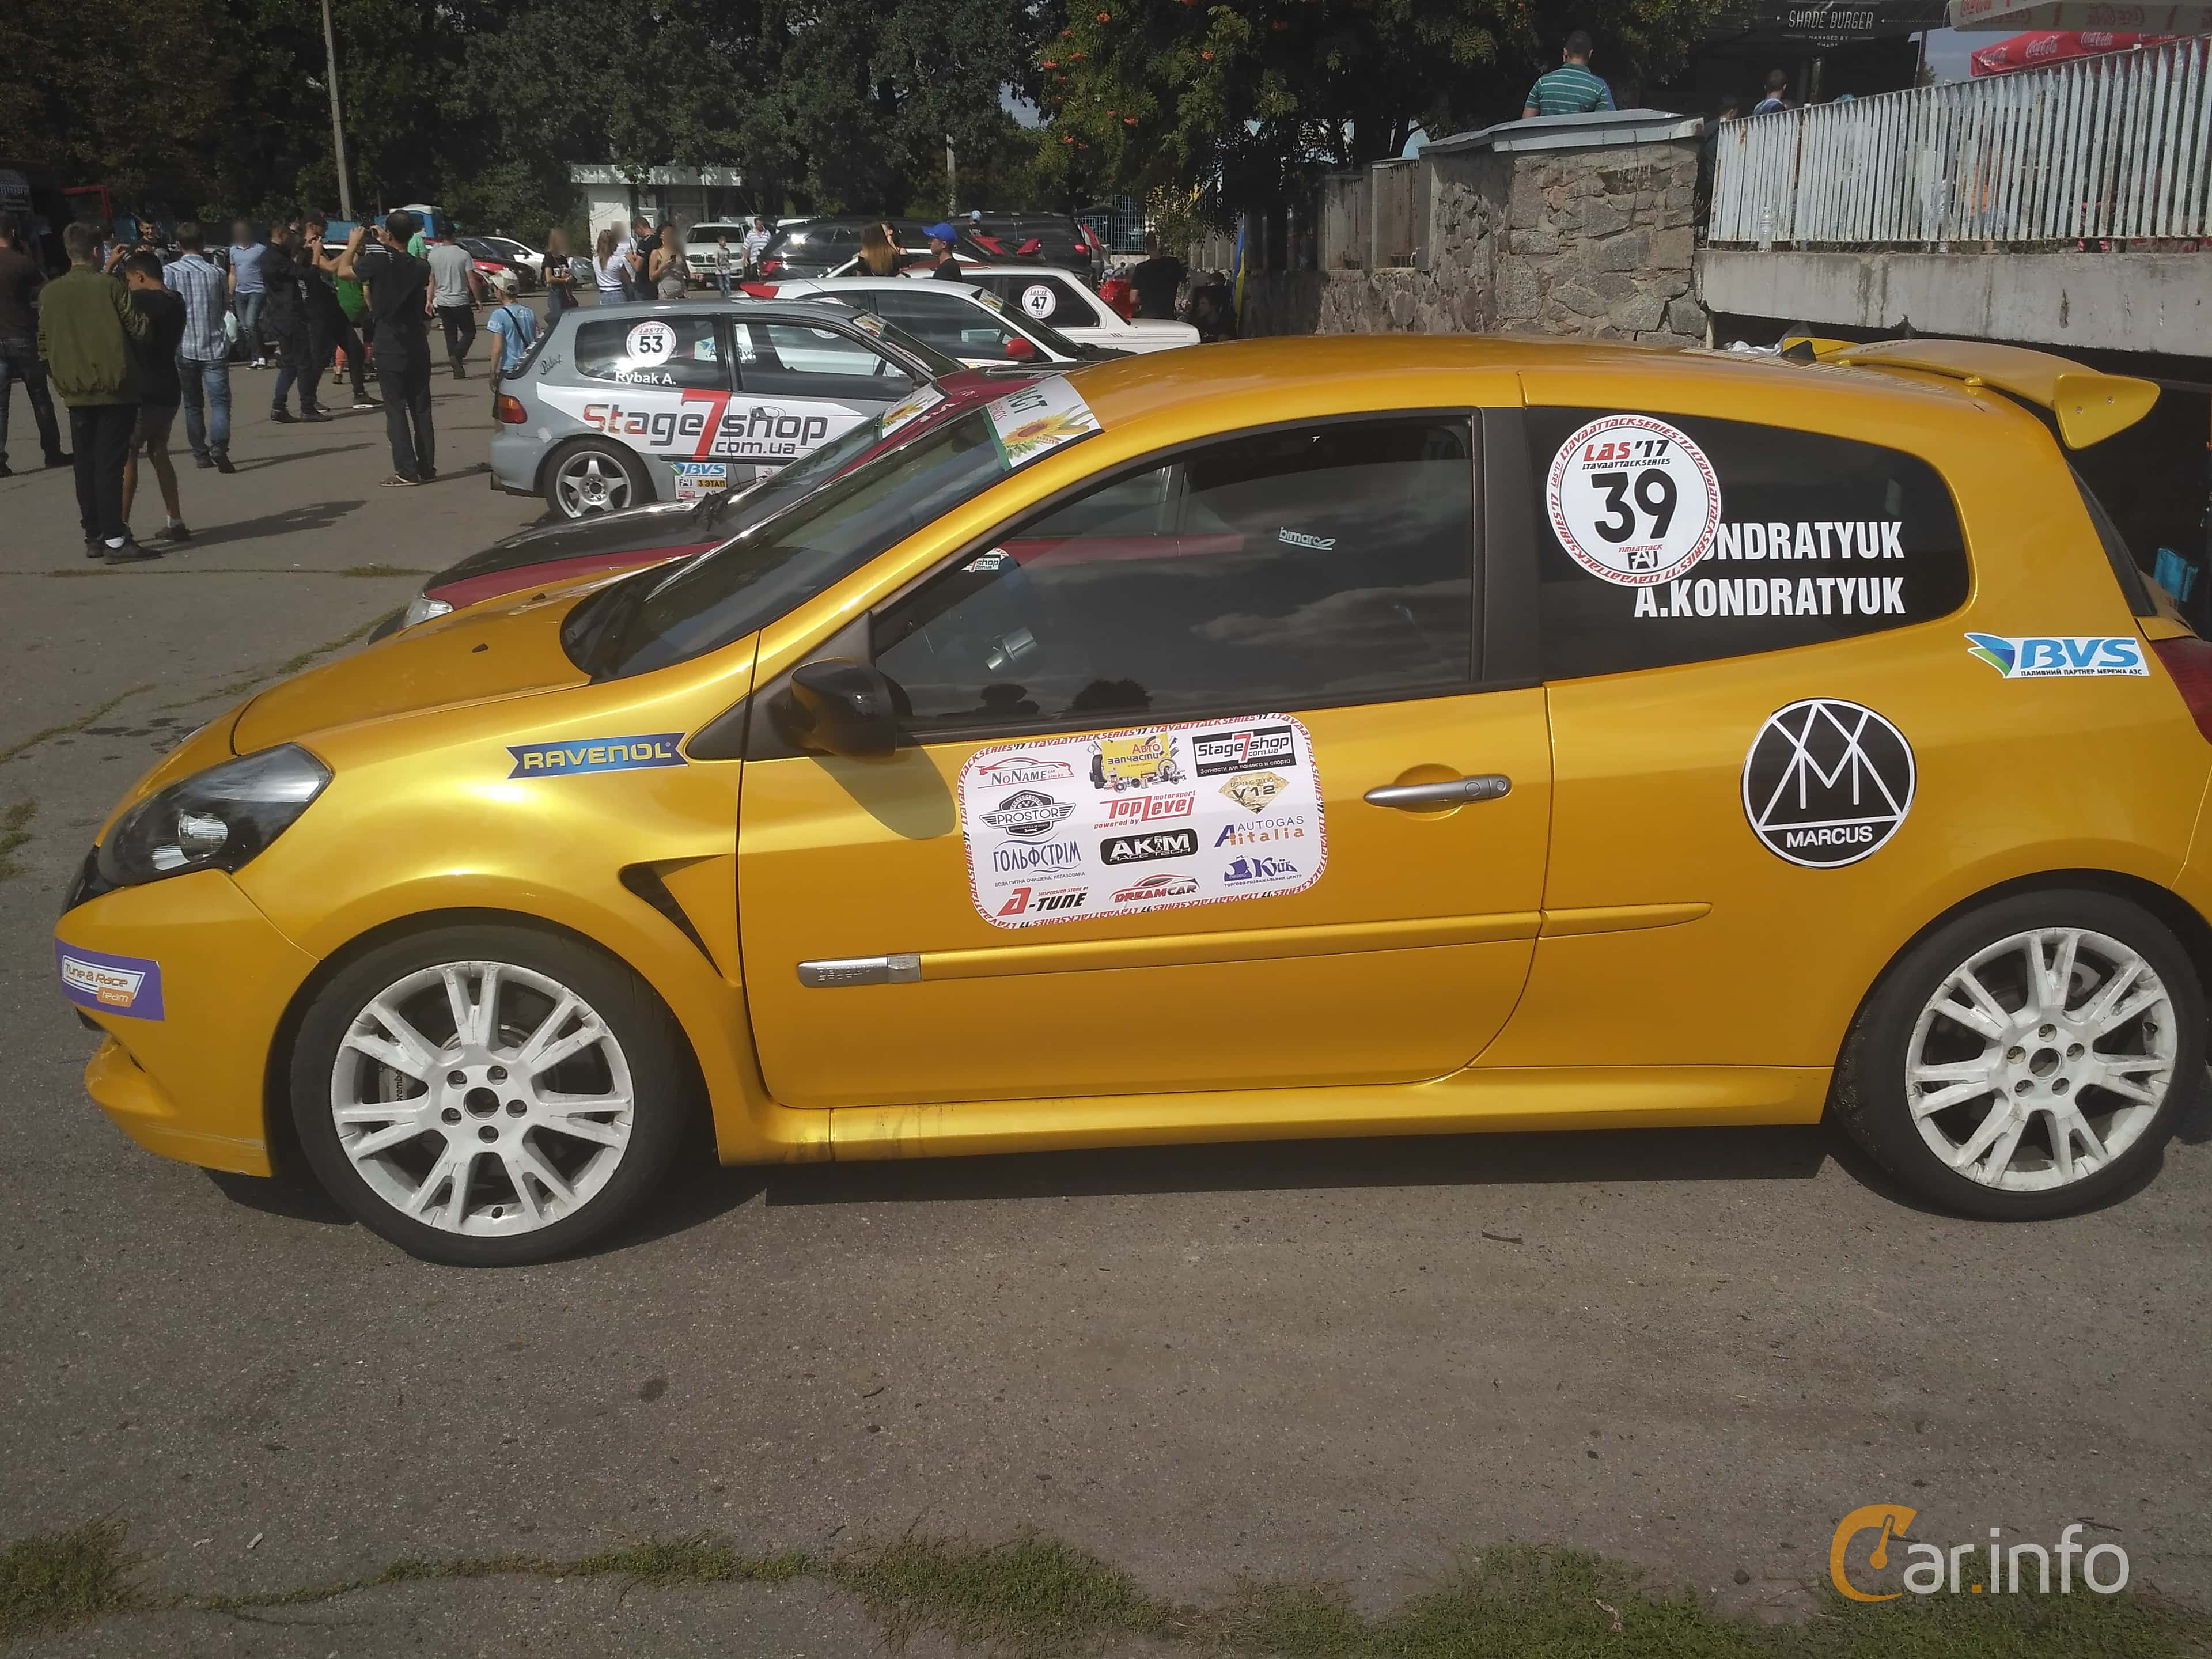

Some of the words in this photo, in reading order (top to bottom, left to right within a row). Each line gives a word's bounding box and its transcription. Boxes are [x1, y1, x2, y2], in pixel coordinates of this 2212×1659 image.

[1789, 10, 1827, 28] SHADE
[1830, 12, 1873, 29] BURGER
[1031, 296, 1047, 310] 47
[639, 335, 664, 354] 53
[615, 371, 659, 385] Rybak
[662, 374, 677, 385] A.
[715, 441, 796, 456] com.ua
[1583, 441, 1631, 462] LAS
[1634, 440, 1670, 458] '17
[685, 464, 725, 475] BVS
[1592, 468, 1677, 543] 39
[1702, 521, 1904, 560] NDRATYUK
[1634, 577, 1906, 618] A.KONDRATYUK
[2020, 639, 2139, 669] BVS
[2021, 668, 2062, 676] ПАЛИВНИЙ
[1198, 733, 1289, 762] Stage7shop
[1248, 749, 1279, 757] com.ua
[523, 743, 672, 770] RAVENOL
[1108, 753, 1159, 764] запчасти
[1200, 766, 1227, 774] Запчасти
[1153, 790, 1196, 801] motorsport
[997, 809, 1059, 824] PROSTOR
[1237, 816, 1304, 832] AUTOGAS
[1094, 819, 1128, 830] powered
[1786, 826, 1873, 848] MARCUS
[993, 840, 1082, 872] ГОЛЬФСТРІМ
[1109, 853, 1149, 862] RACE
[1152, 847, 1191, 856] TECH
[1054, 872, 1085, 880] НЕГАЗОВАНА
[1114, 885, 1197, 903] DREAMCAR
[64, 963, 85, 979] Tune
[86, 971, 94, 982] &
[95, 972, 128, 987] Race
[101, 991, 129, 1002] team
